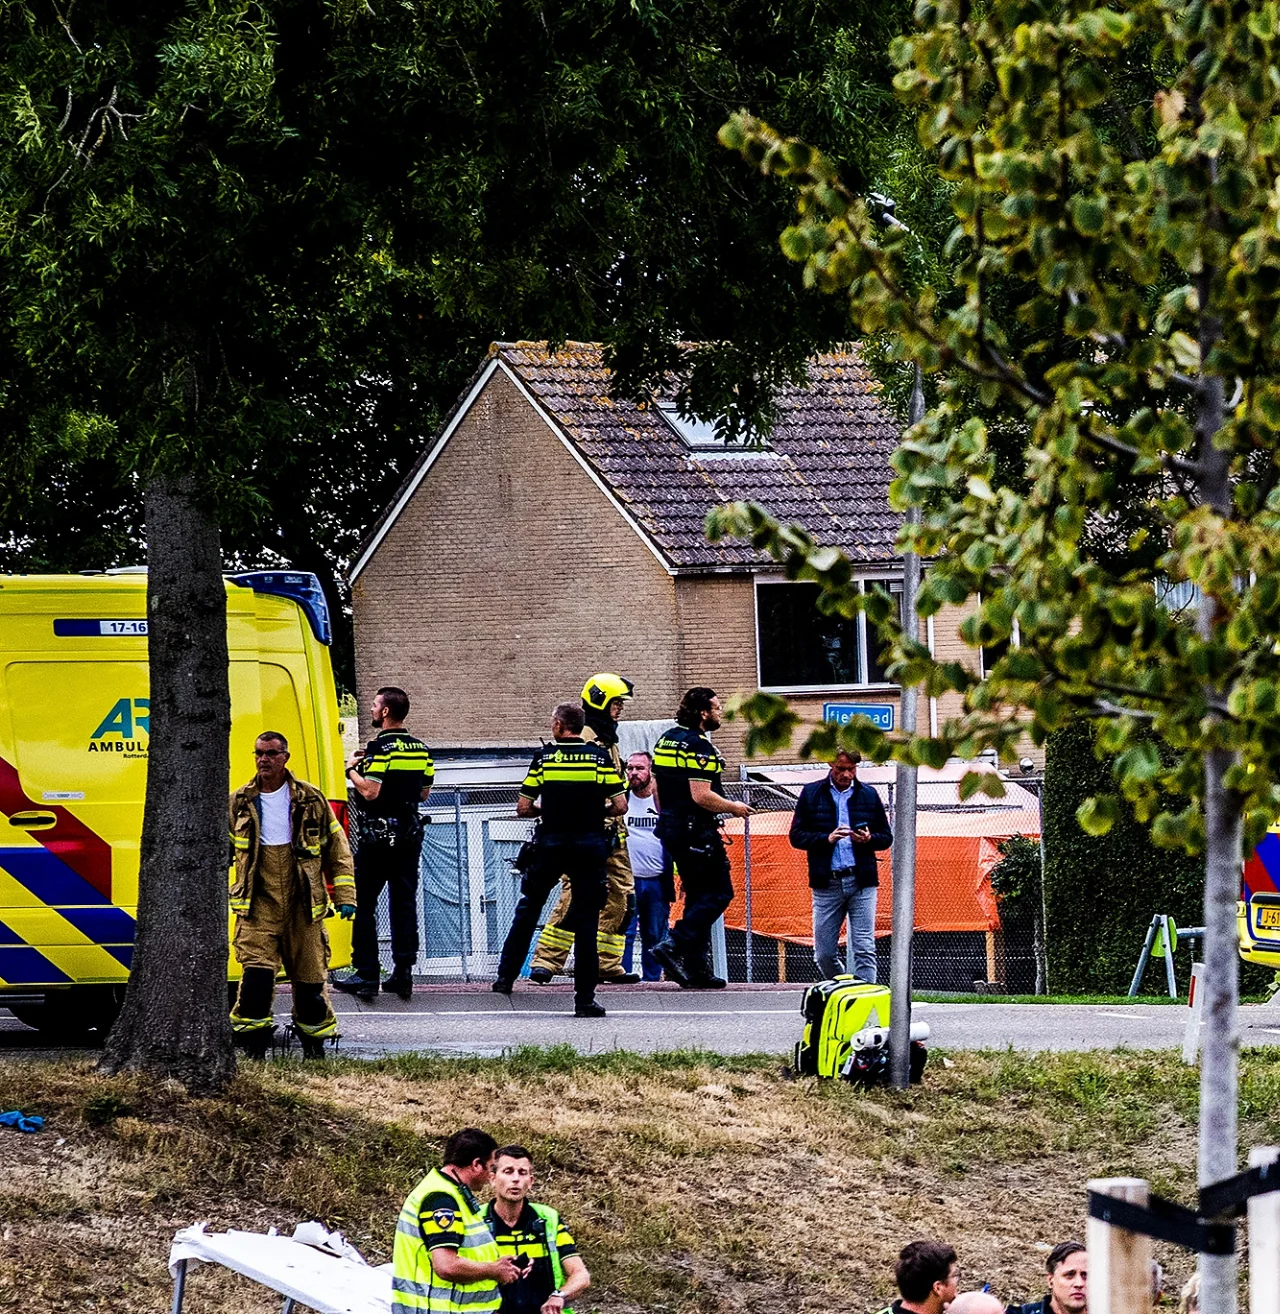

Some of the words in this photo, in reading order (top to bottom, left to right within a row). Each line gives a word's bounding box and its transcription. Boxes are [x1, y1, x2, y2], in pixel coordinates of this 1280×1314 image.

[110, 622, 149, 633] 17-16
[88, 741, 149, 752] AMBUL
[627, 816, 658, 828] PUMA
